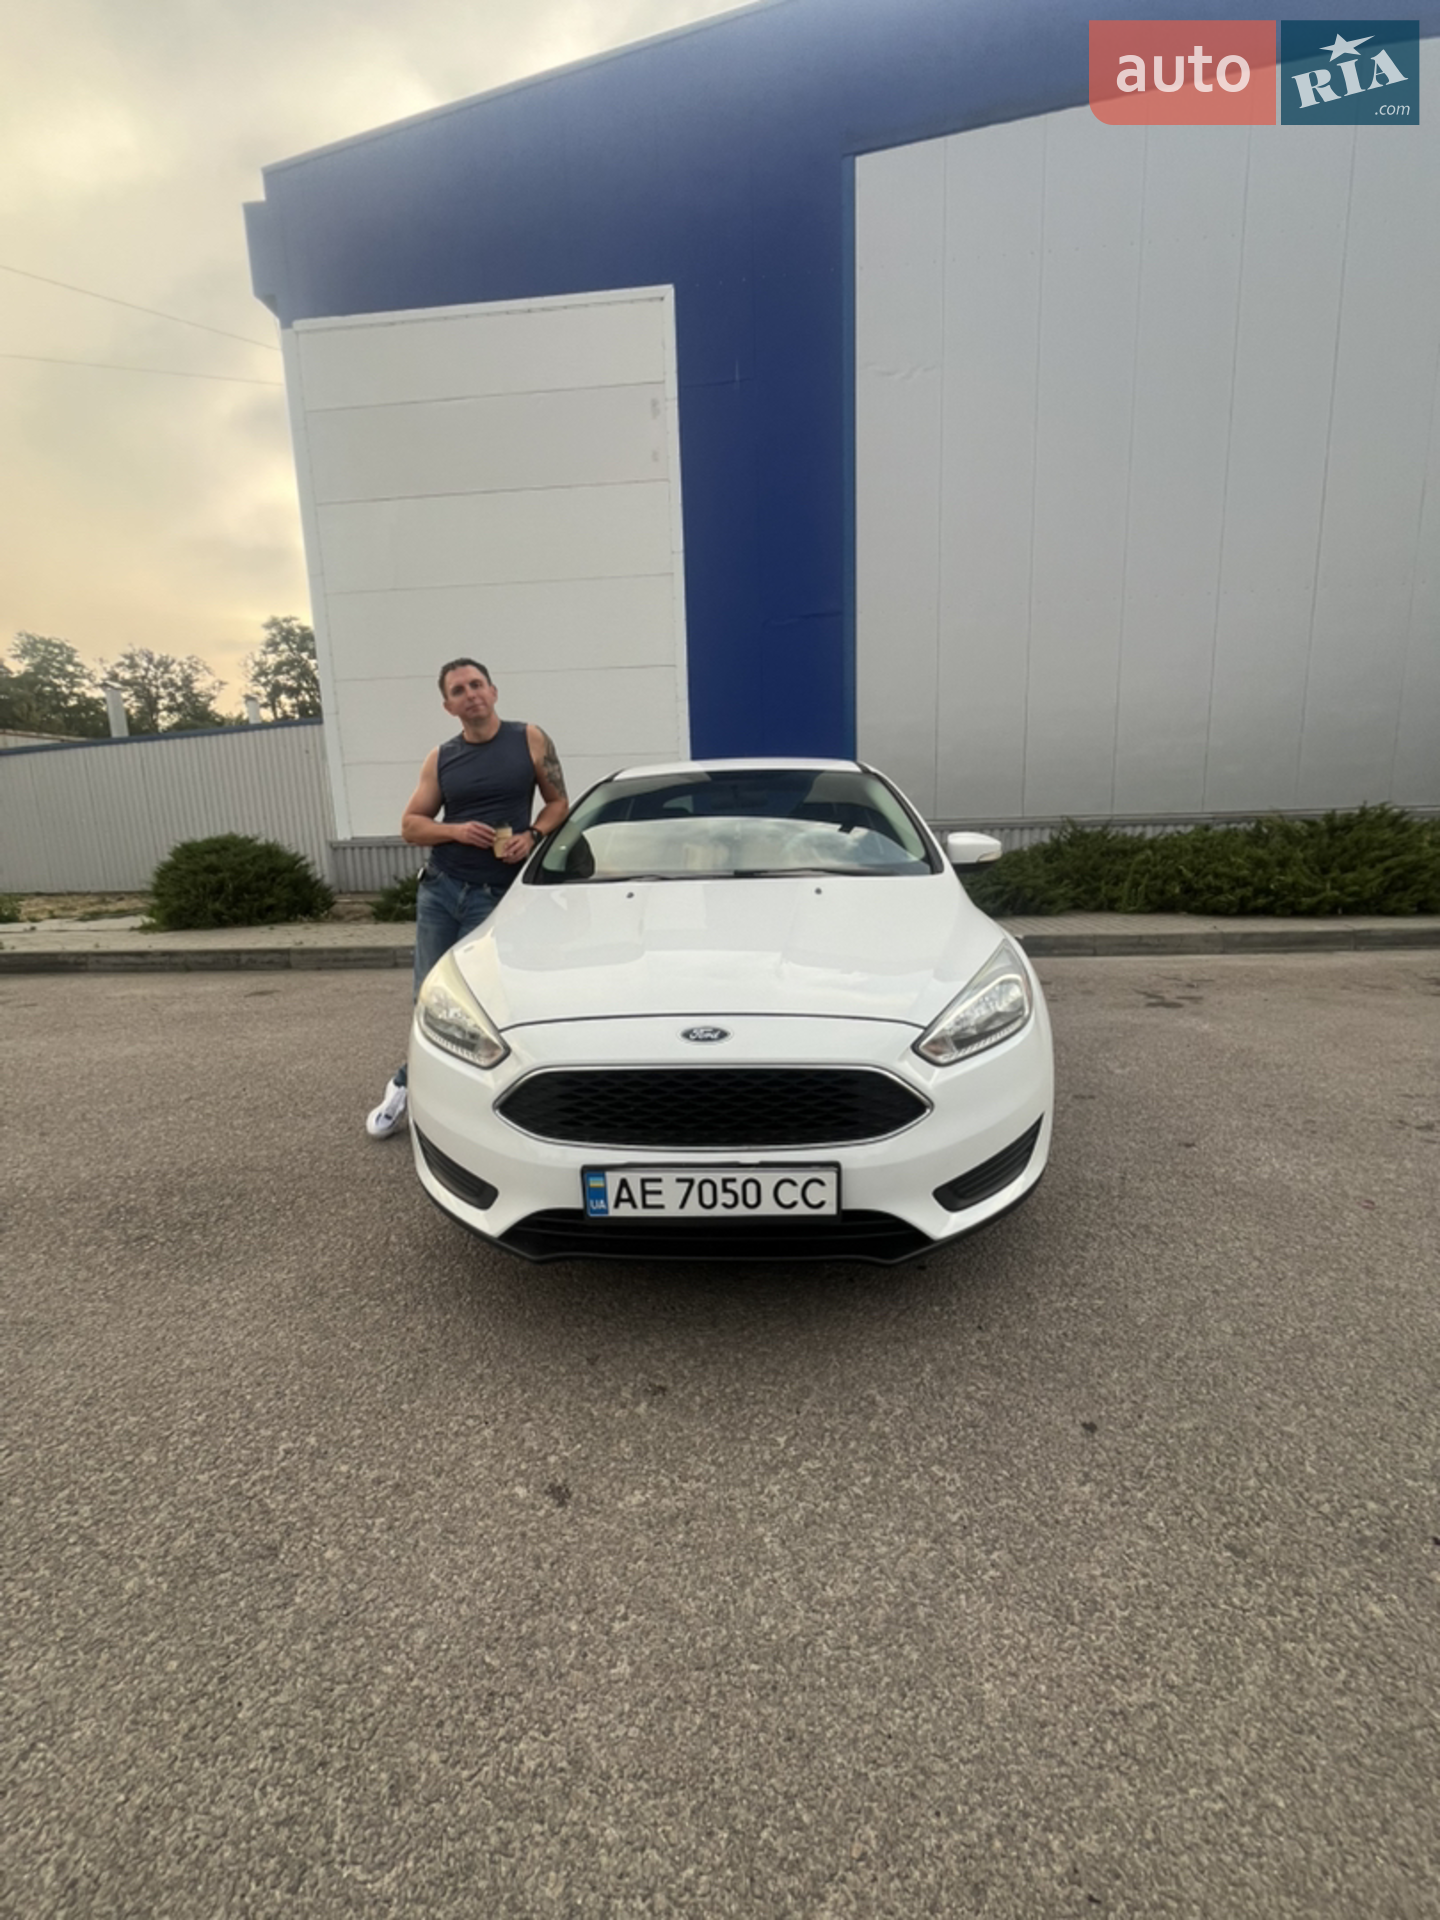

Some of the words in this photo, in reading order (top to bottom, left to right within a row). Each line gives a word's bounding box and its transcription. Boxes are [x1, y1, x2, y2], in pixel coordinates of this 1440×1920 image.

[689, 1028, 721, 1040] Ford
[613, 1177, 665, 1210] AE
[675, 1177, 762, 1210] 7050
[772, 1177, 827, 1210] CC
[590, 1199, 607, 1210] UA
